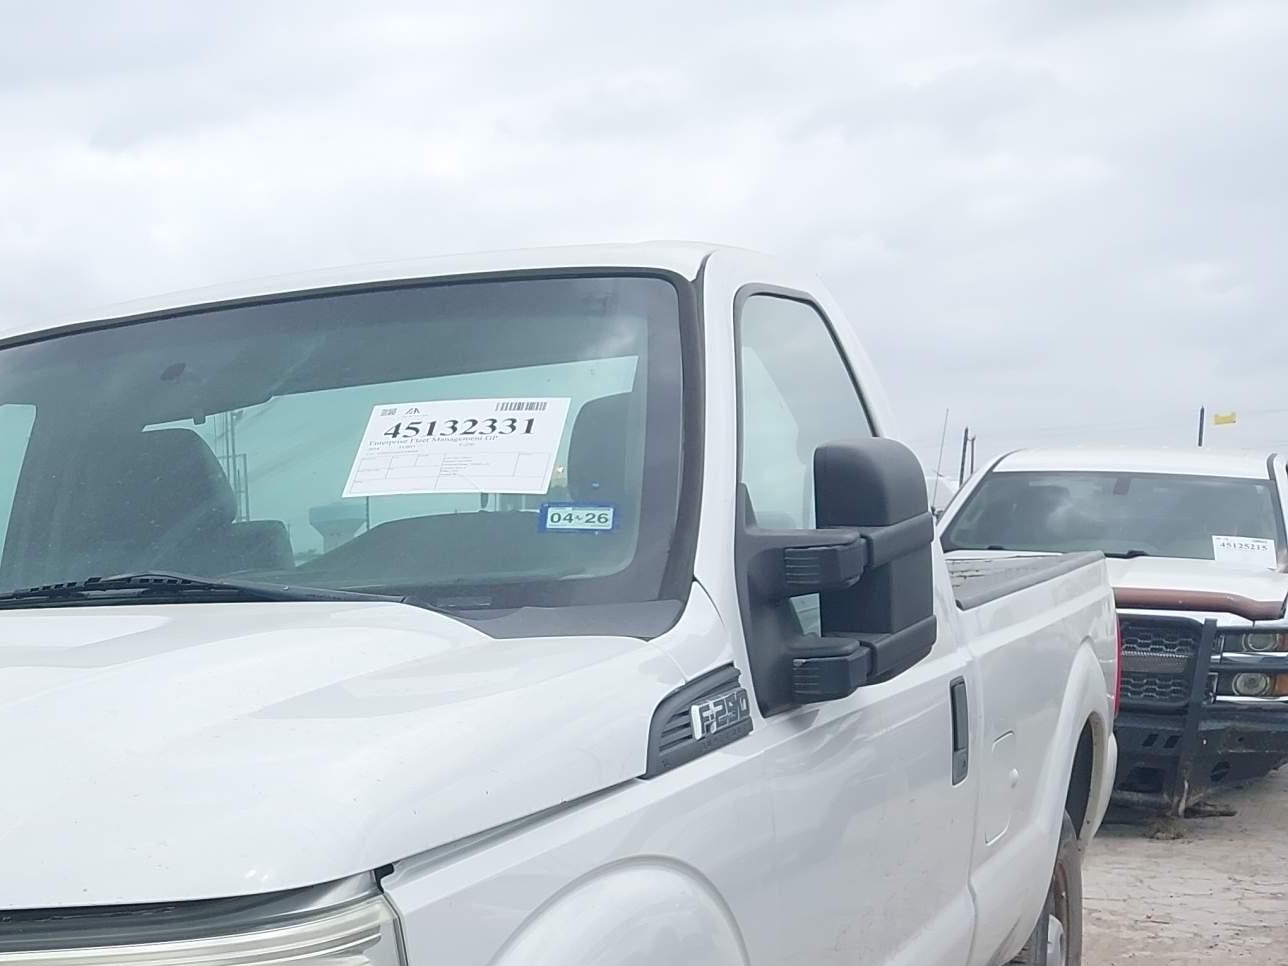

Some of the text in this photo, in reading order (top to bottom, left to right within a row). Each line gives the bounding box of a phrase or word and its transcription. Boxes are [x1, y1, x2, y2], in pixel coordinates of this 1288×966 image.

[383, 417, 535, 438] 45132331
[550, 512, 609, 524] 04 26
